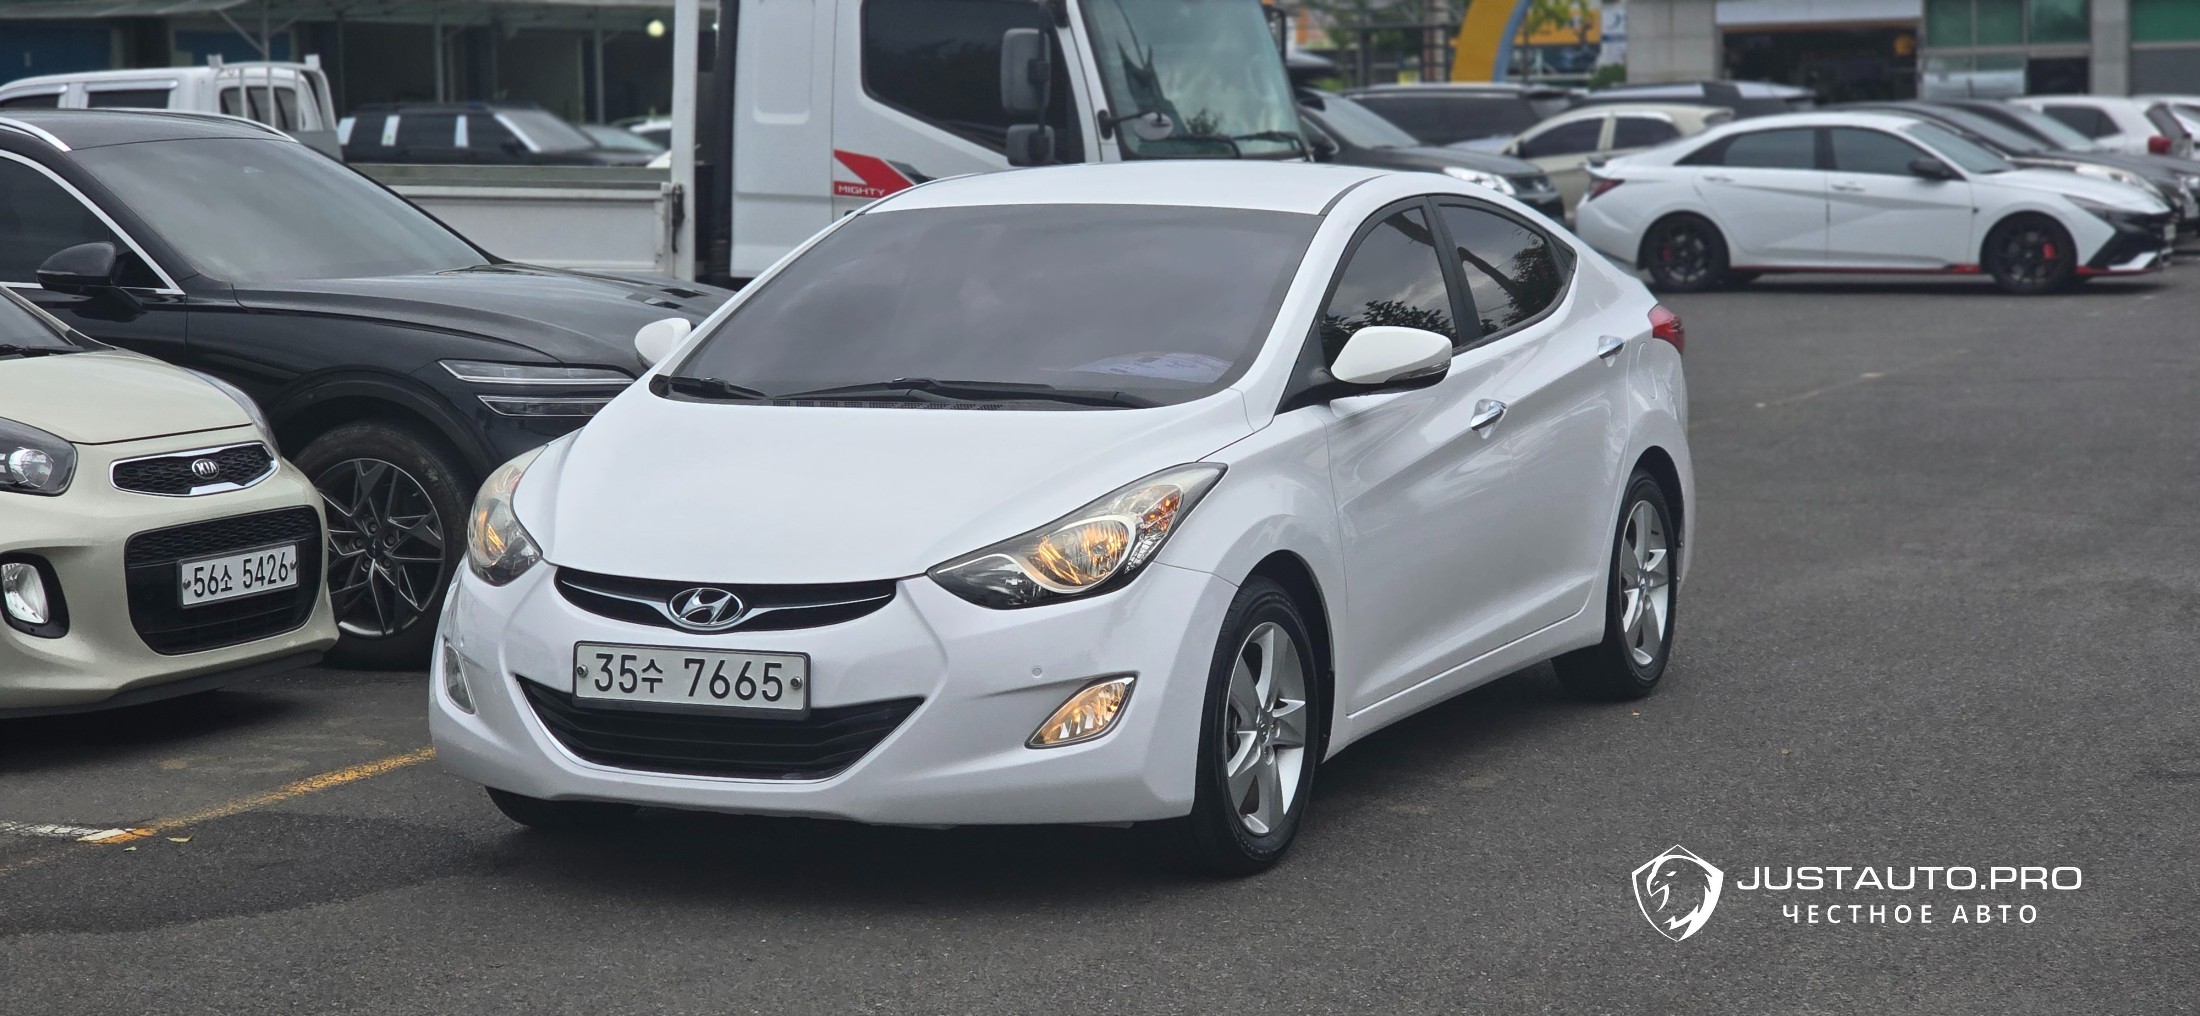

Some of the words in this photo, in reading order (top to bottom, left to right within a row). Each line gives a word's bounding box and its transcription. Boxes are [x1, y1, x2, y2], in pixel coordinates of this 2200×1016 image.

[838, 185, 885, 196] MIGHTY
[196, 461, 217, 475] KIA
[193, 564, 233, 598] 56소
[242, 552, 289, 590] 5426
[594, 653, 664, 694] 35수
[683, 658, 783, 702] 7665
